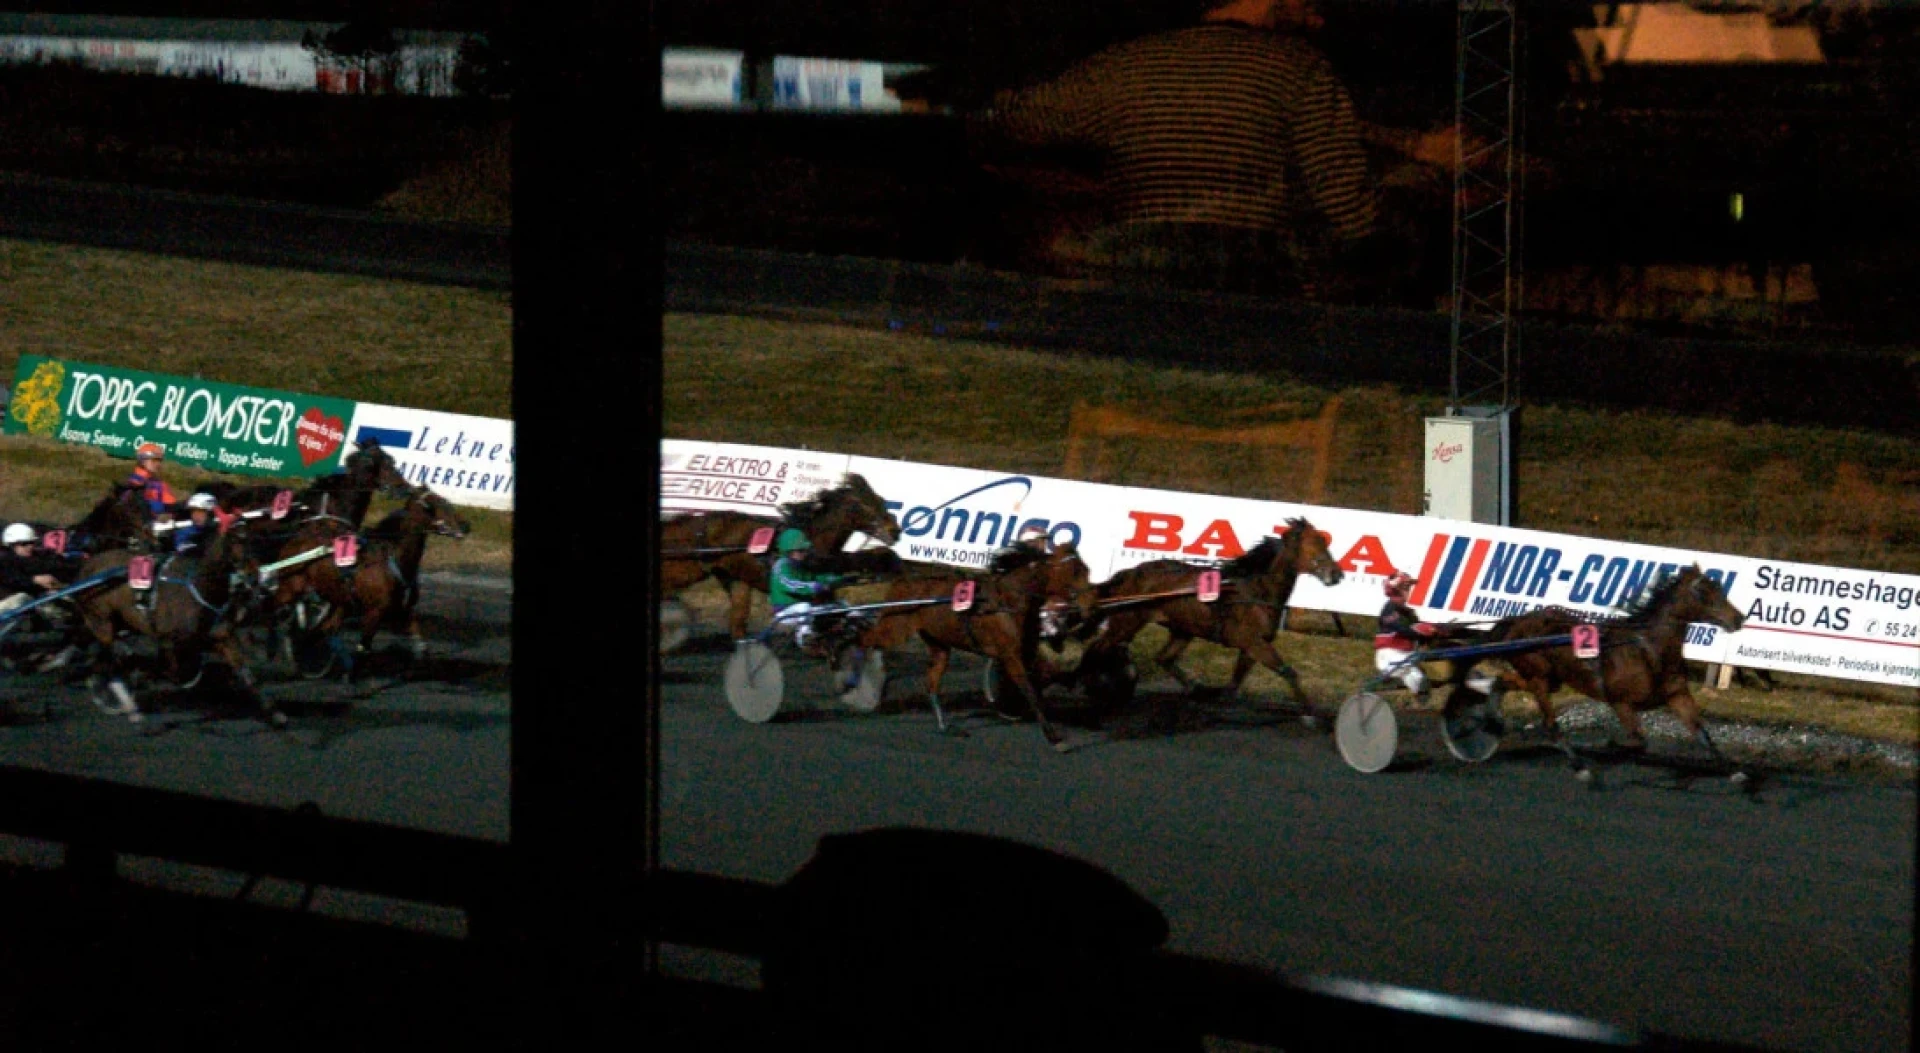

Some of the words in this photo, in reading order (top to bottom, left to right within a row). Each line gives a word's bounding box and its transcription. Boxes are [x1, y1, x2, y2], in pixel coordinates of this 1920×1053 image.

[66, 371, 157, 427] TOPPE
[155, 385, 295, 447] BLOMSTER
[93, 429, 127, 447] Senter
[175, 441, 208, 460] Kilden
[217, 446, 249, 467] Toppe
[250, 452, 284, 471] Senter
[686, 453, 772, 477] ELEKTRO
[775, 461, 789, 480] &
[399, 460, 514, 494] AINERSERVI
[752, 484, 782, 503] AS
[910, 543, 994, 567] www.sonni
[1122, 510, 1398, 577] BAA
[1480, 541, 1739, 608] NOR-CONT
[1747, 597, 1806, 626] Auto
[1812, 605, 1852, 631] AS
[1884, 622, 1901, 637] 55
[1901, 624, 1918, 638] 24
[1579, 627, 1594, 649] 2
[1736, 643, 1781, 662] Autorisert
[1782, 650, 1832, 668] bilverksted
[1836, 656, 1881, 673] Periodisk
